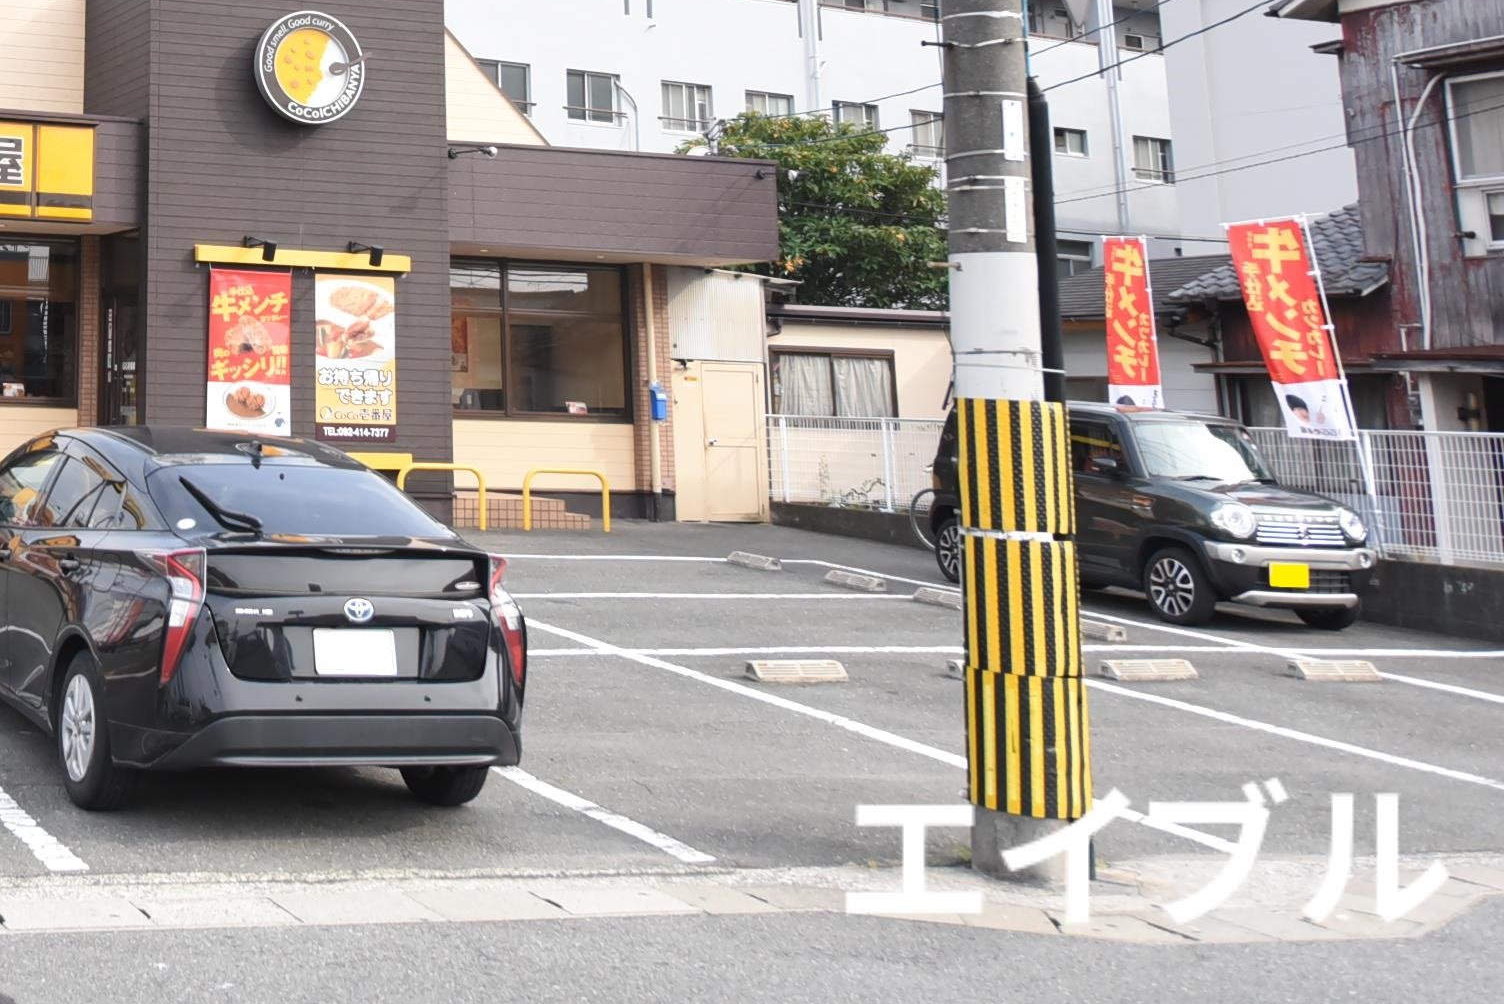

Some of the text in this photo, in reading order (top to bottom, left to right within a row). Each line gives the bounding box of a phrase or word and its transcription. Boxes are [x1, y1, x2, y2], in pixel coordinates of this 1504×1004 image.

[264, 45, 275, 72] Good
[287, 15, 311, 29] Good
[312, 18, 335, 31] curry
[317, 367, 393, 387] お持ち帰り
[335, 387, 393, 406] できます
